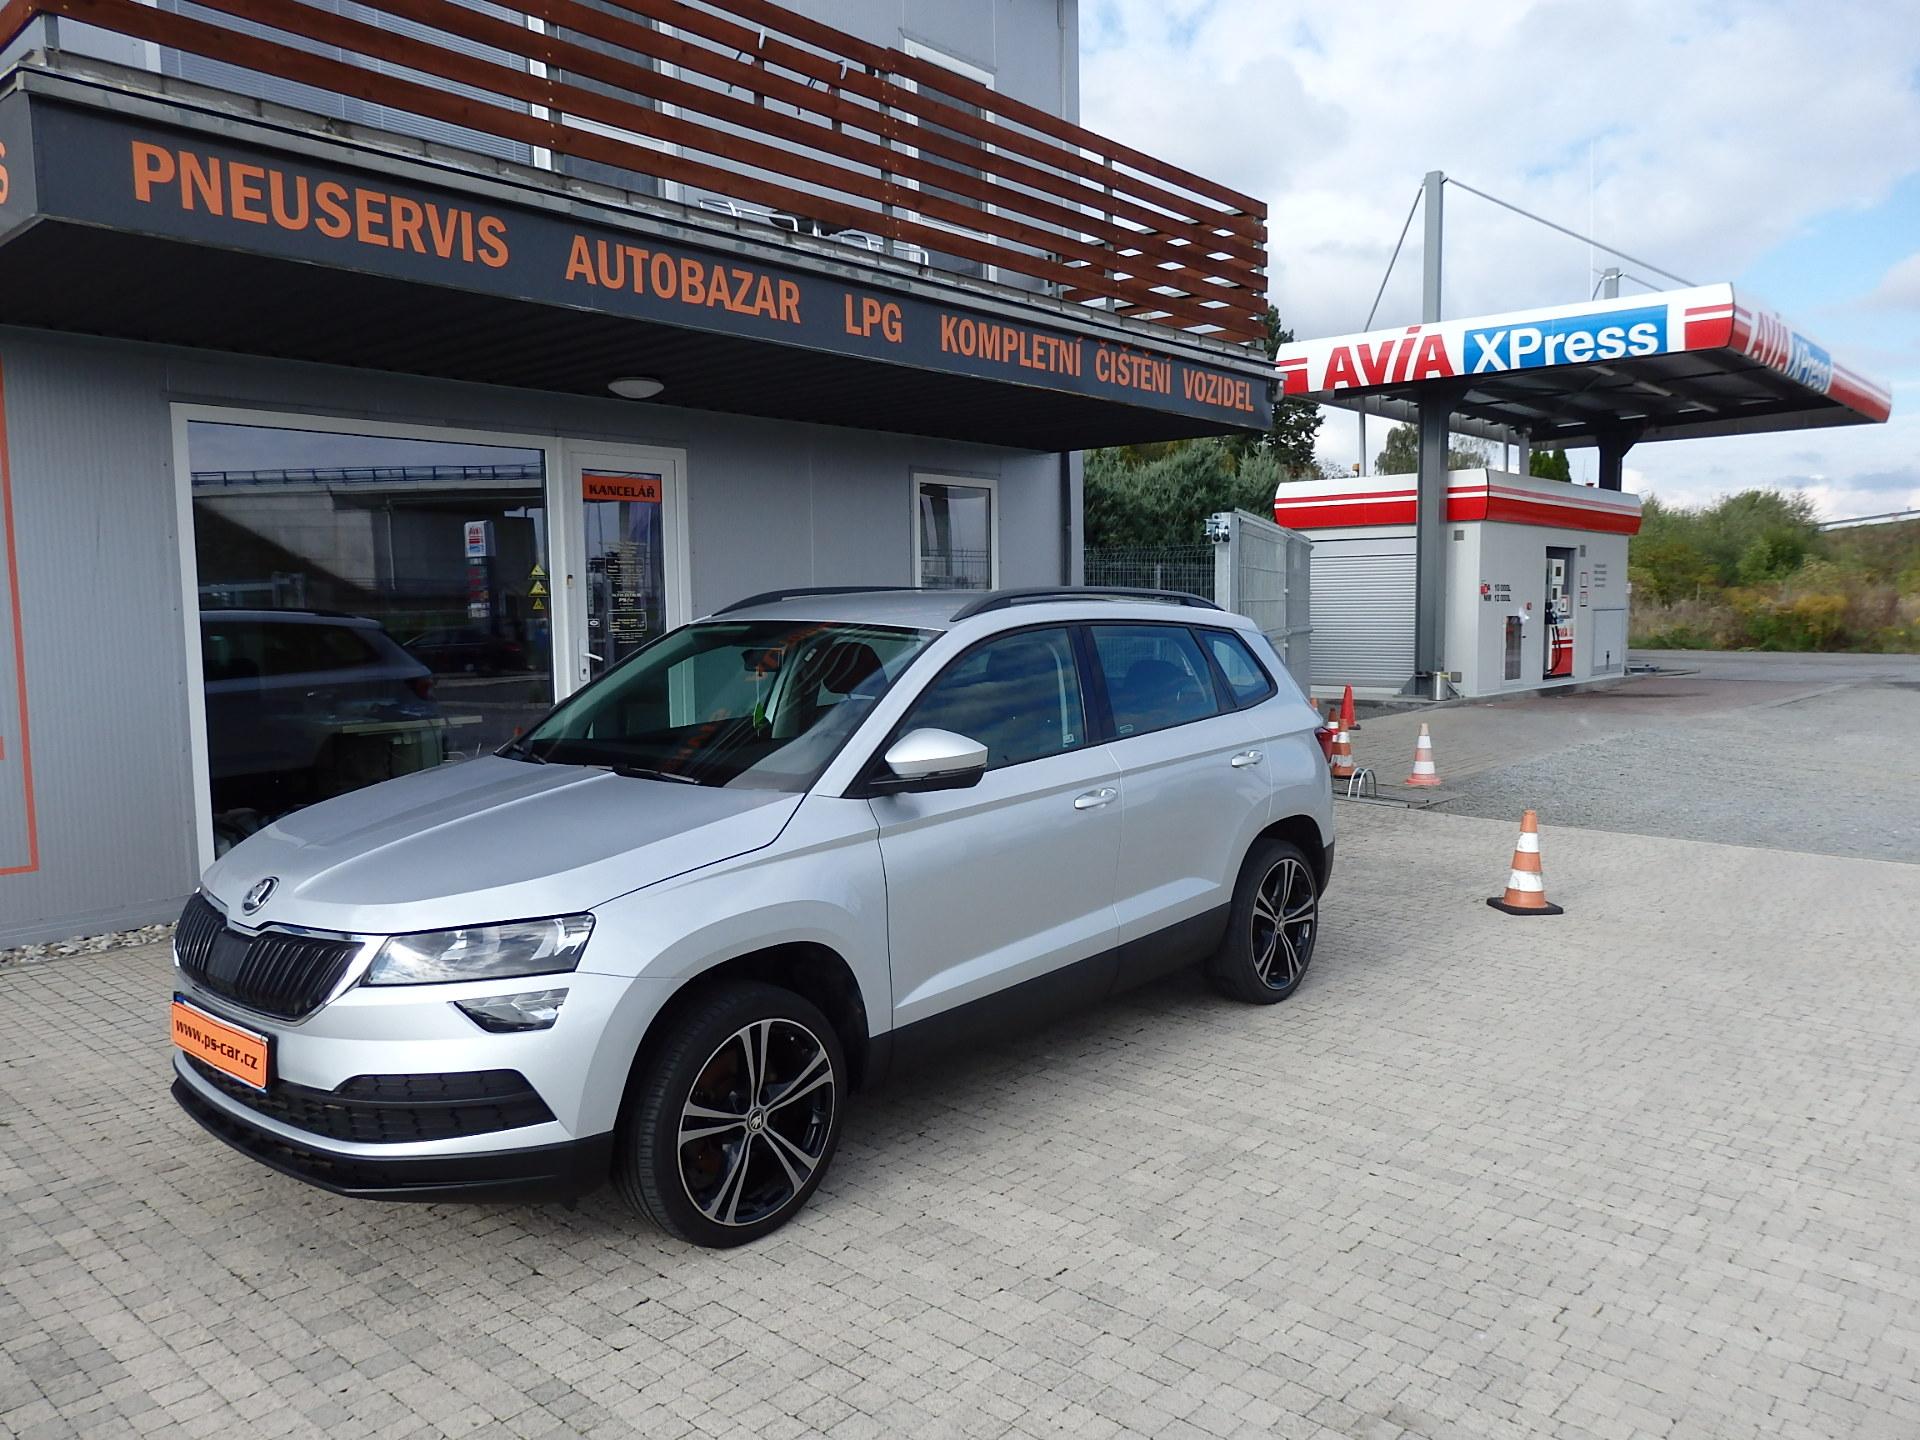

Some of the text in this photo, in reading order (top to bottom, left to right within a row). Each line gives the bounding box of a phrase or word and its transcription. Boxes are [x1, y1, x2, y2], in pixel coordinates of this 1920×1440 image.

[131, 140, 1254, 412] PNEUSERVIS AUTOBAZAR LPG KOMPLETNÍ ČIŠTĚNÍ VOZIDEL
[1473, 322, 1660, 374] XPress
[176, 1020, 258, 1070] www.ps-car.cz
